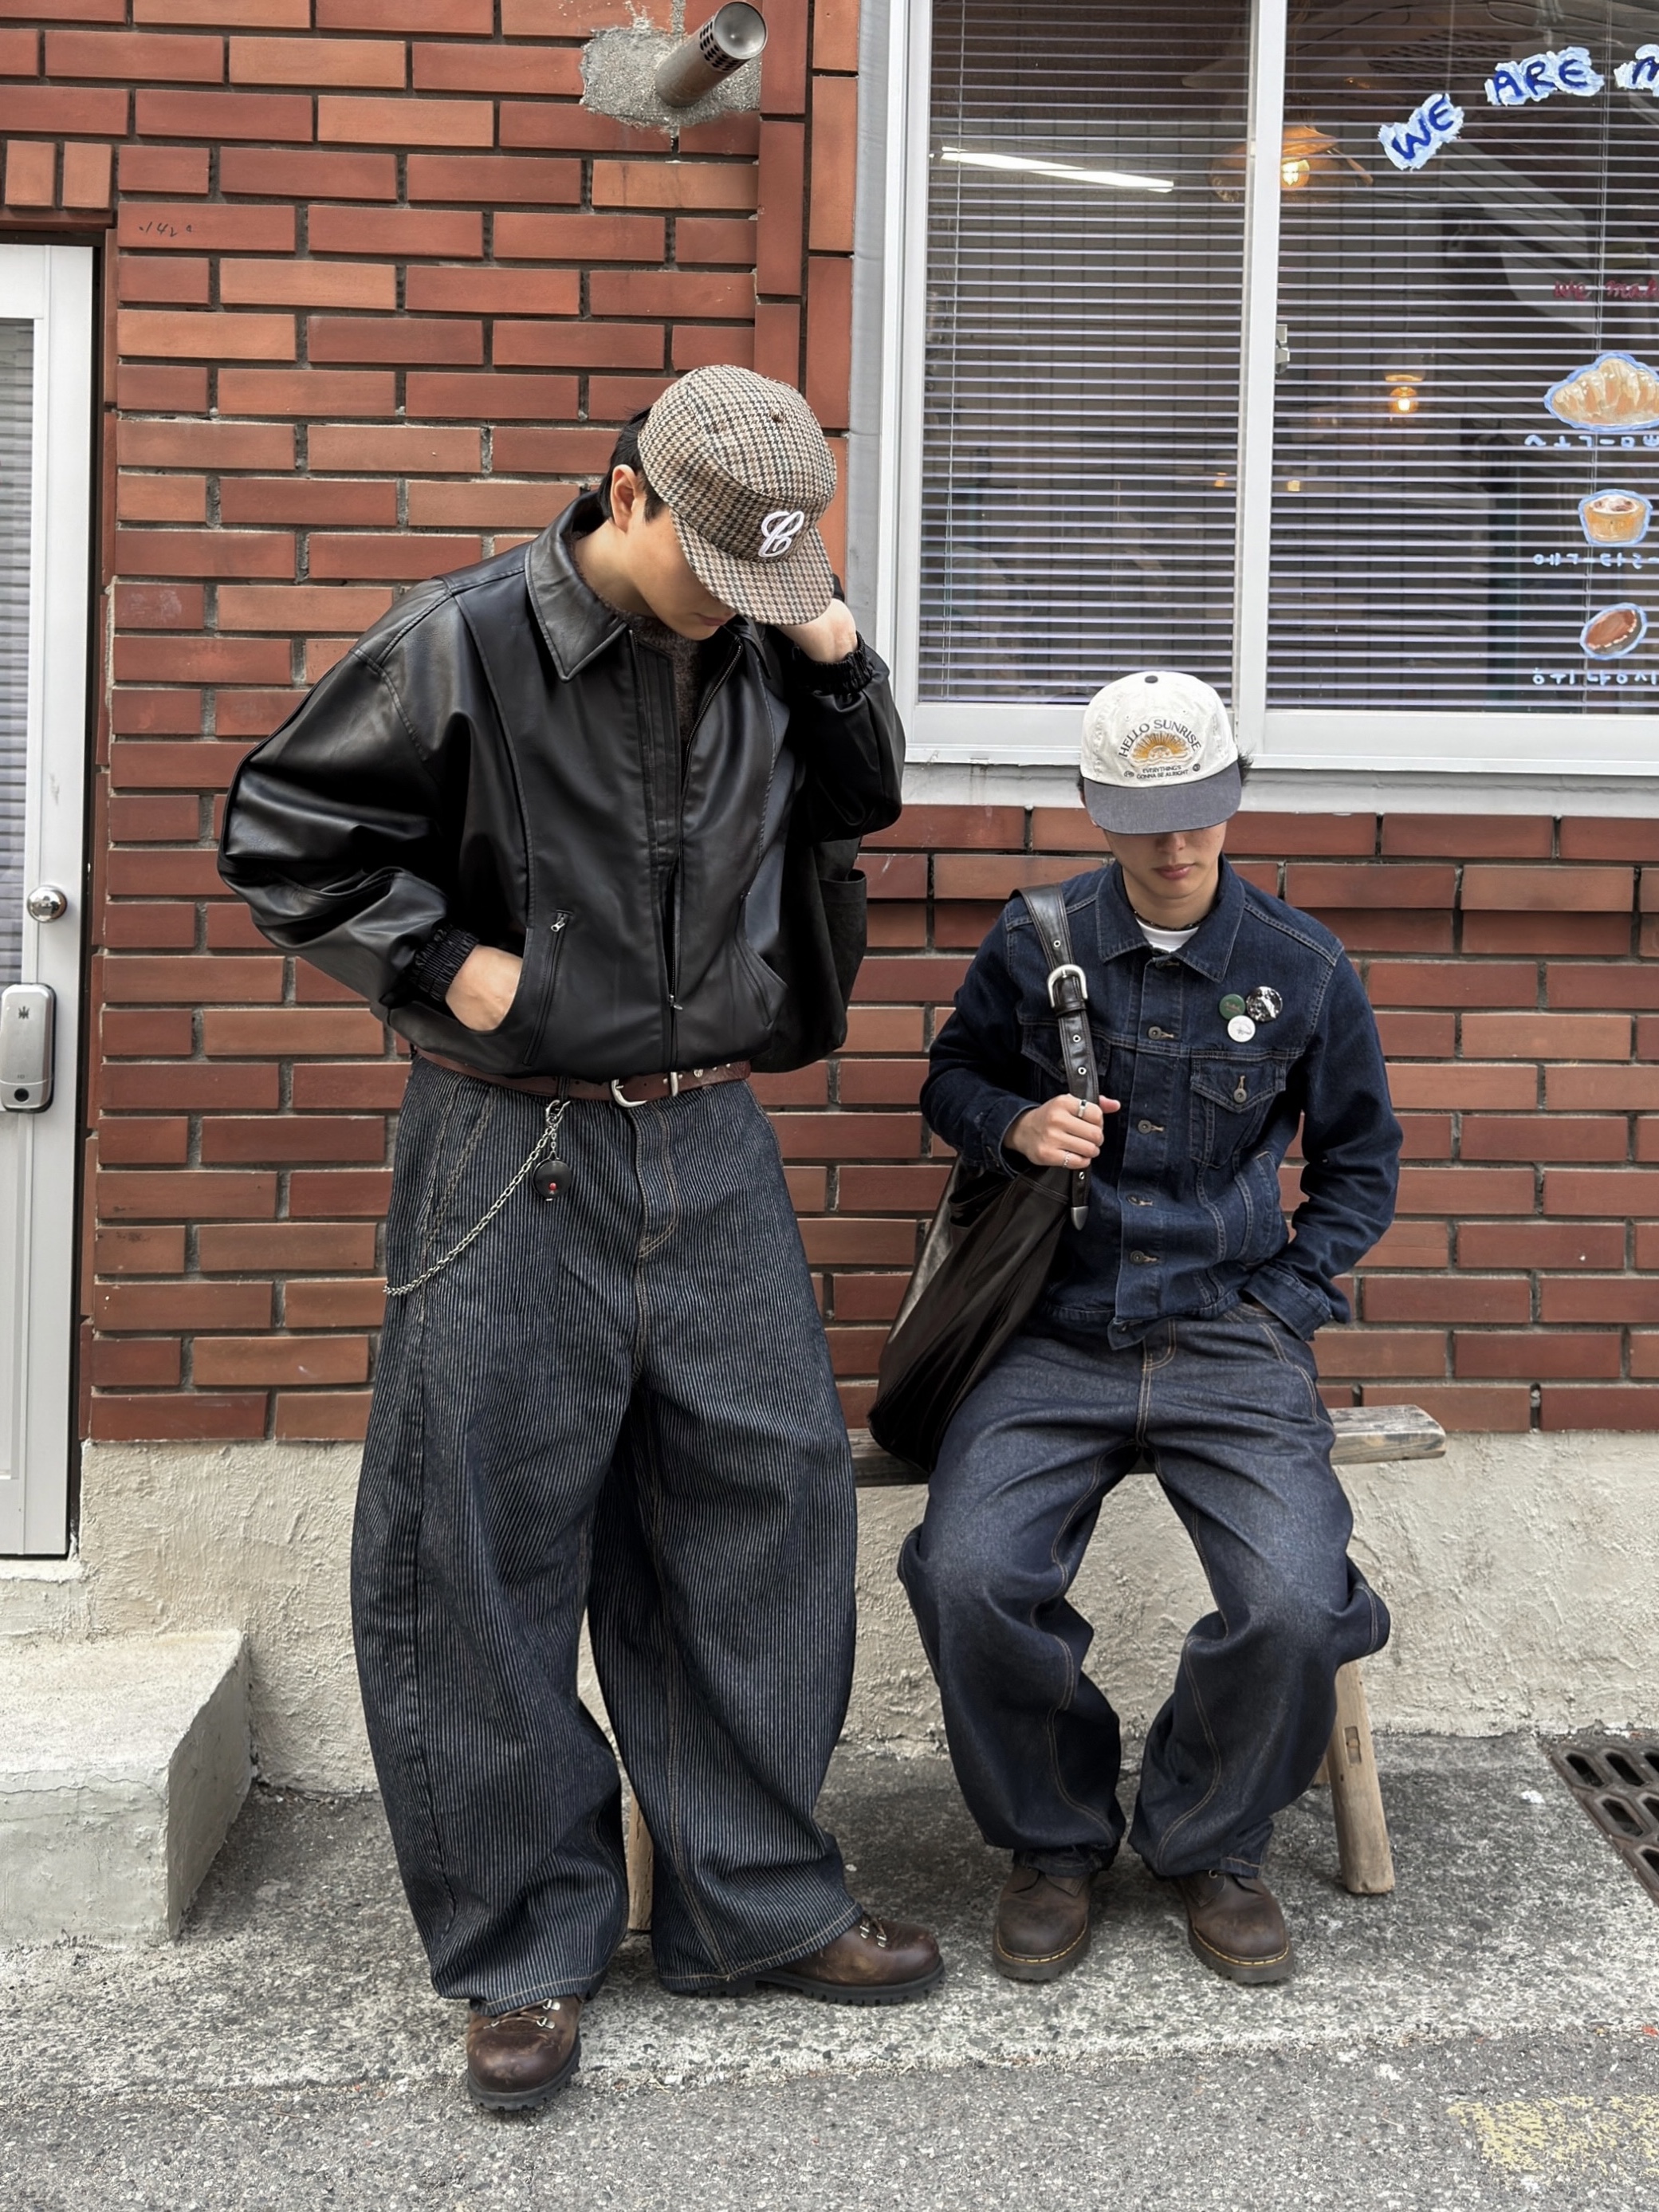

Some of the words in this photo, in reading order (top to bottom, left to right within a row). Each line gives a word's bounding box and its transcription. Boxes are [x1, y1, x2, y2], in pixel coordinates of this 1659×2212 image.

[1390, 93, 1456, 161] WE
[1492, 59, 1589, 104] ARE
[1118, 722, 1150, 758] HELLO
[1153, 718, 1202, 752] SUNRISE
[1165, 769, 1189, 777] ALRIGHT
